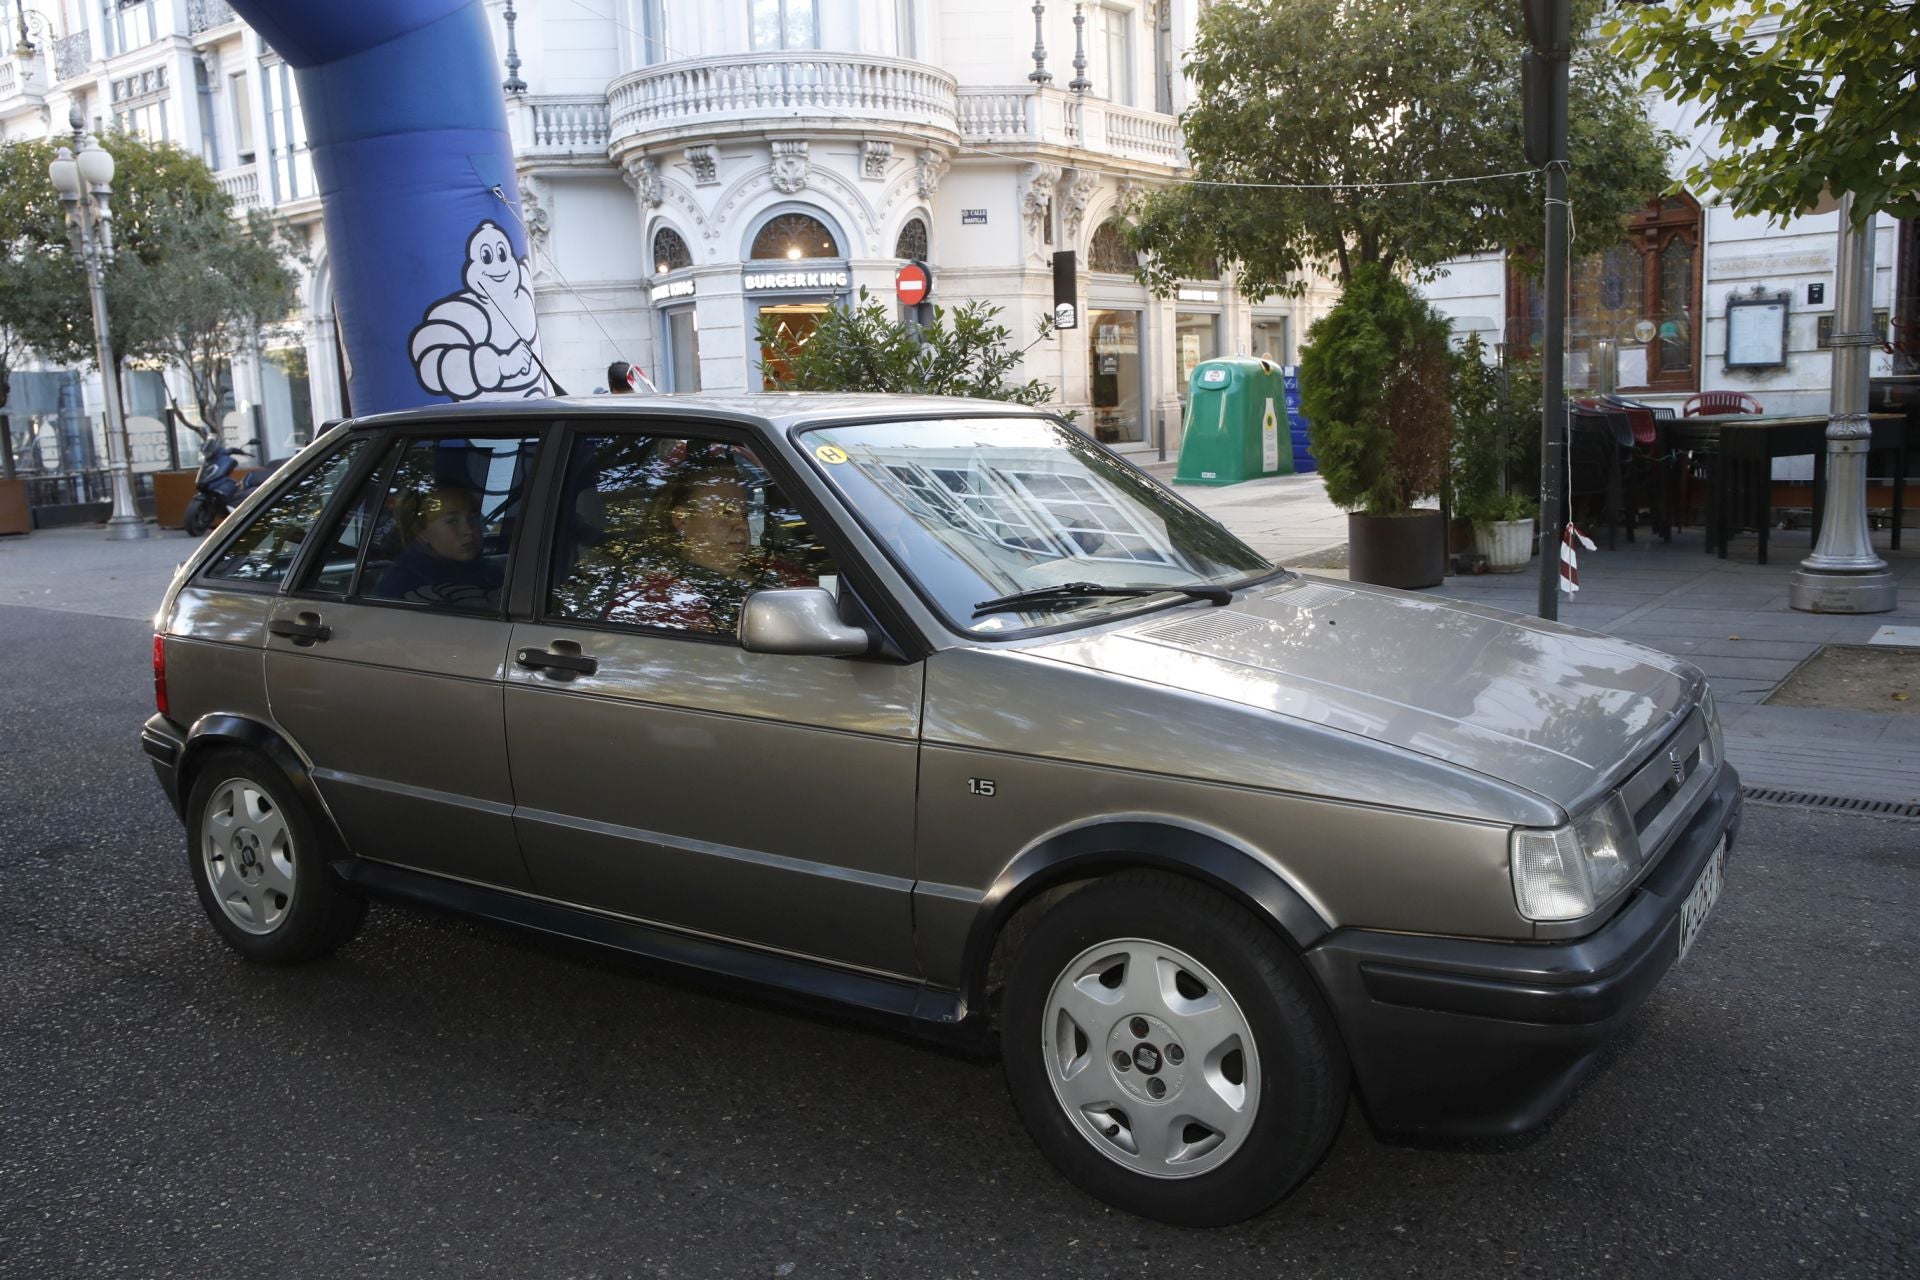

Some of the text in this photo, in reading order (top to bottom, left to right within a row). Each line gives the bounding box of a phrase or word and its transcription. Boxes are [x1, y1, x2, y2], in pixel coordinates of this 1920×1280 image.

[745, 272, 847, 289] BURGER KING
[820, 448, 842, 462] H
[967, 778, 995, 796] 1.5
